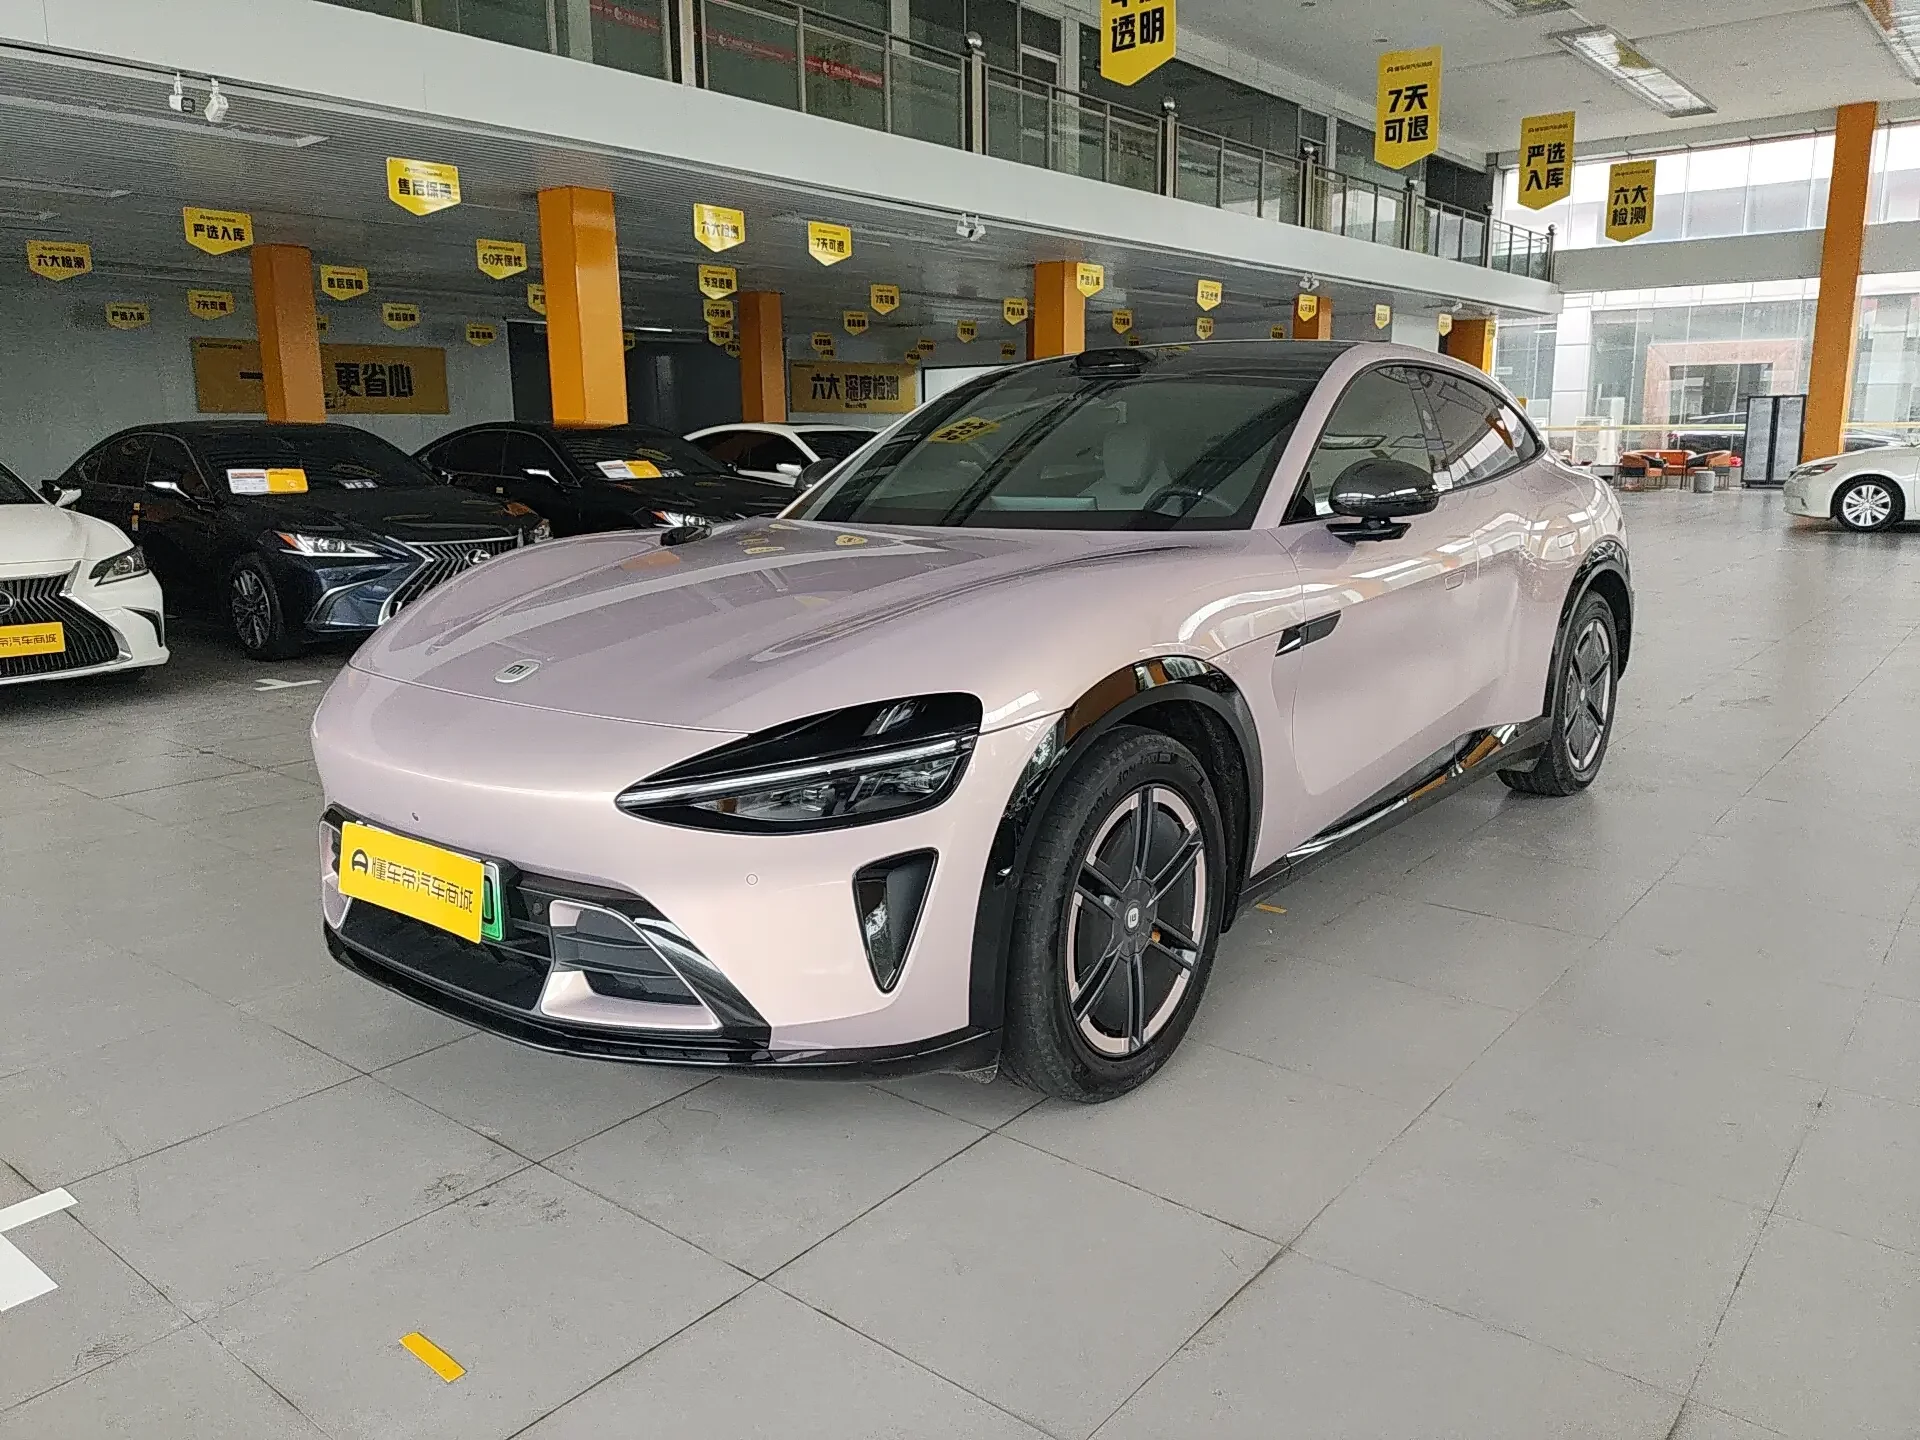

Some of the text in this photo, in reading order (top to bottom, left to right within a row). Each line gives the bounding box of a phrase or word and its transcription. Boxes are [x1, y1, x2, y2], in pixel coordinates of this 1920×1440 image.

[1111, 6, 1165, 53] 透明
[1388, 83, 1429, 114] 7天
[1384, 115, 1429, 143] 可退
[1526, 142, 1566, 167] 严选
[1525, 167, 1565, 191] 入库
[1613, 184, 1649, 206] 六大
[1612, 206, 1647, 226] 检测
[193, 222, 246, 242] 严选入库
[36, 254, 85, 269] 六大检测
[335, 362, 414, 397] 更省心
[811, 373, 841, 400] 六大
[371, 857, 474, 914] 懂车帝汽车商城
